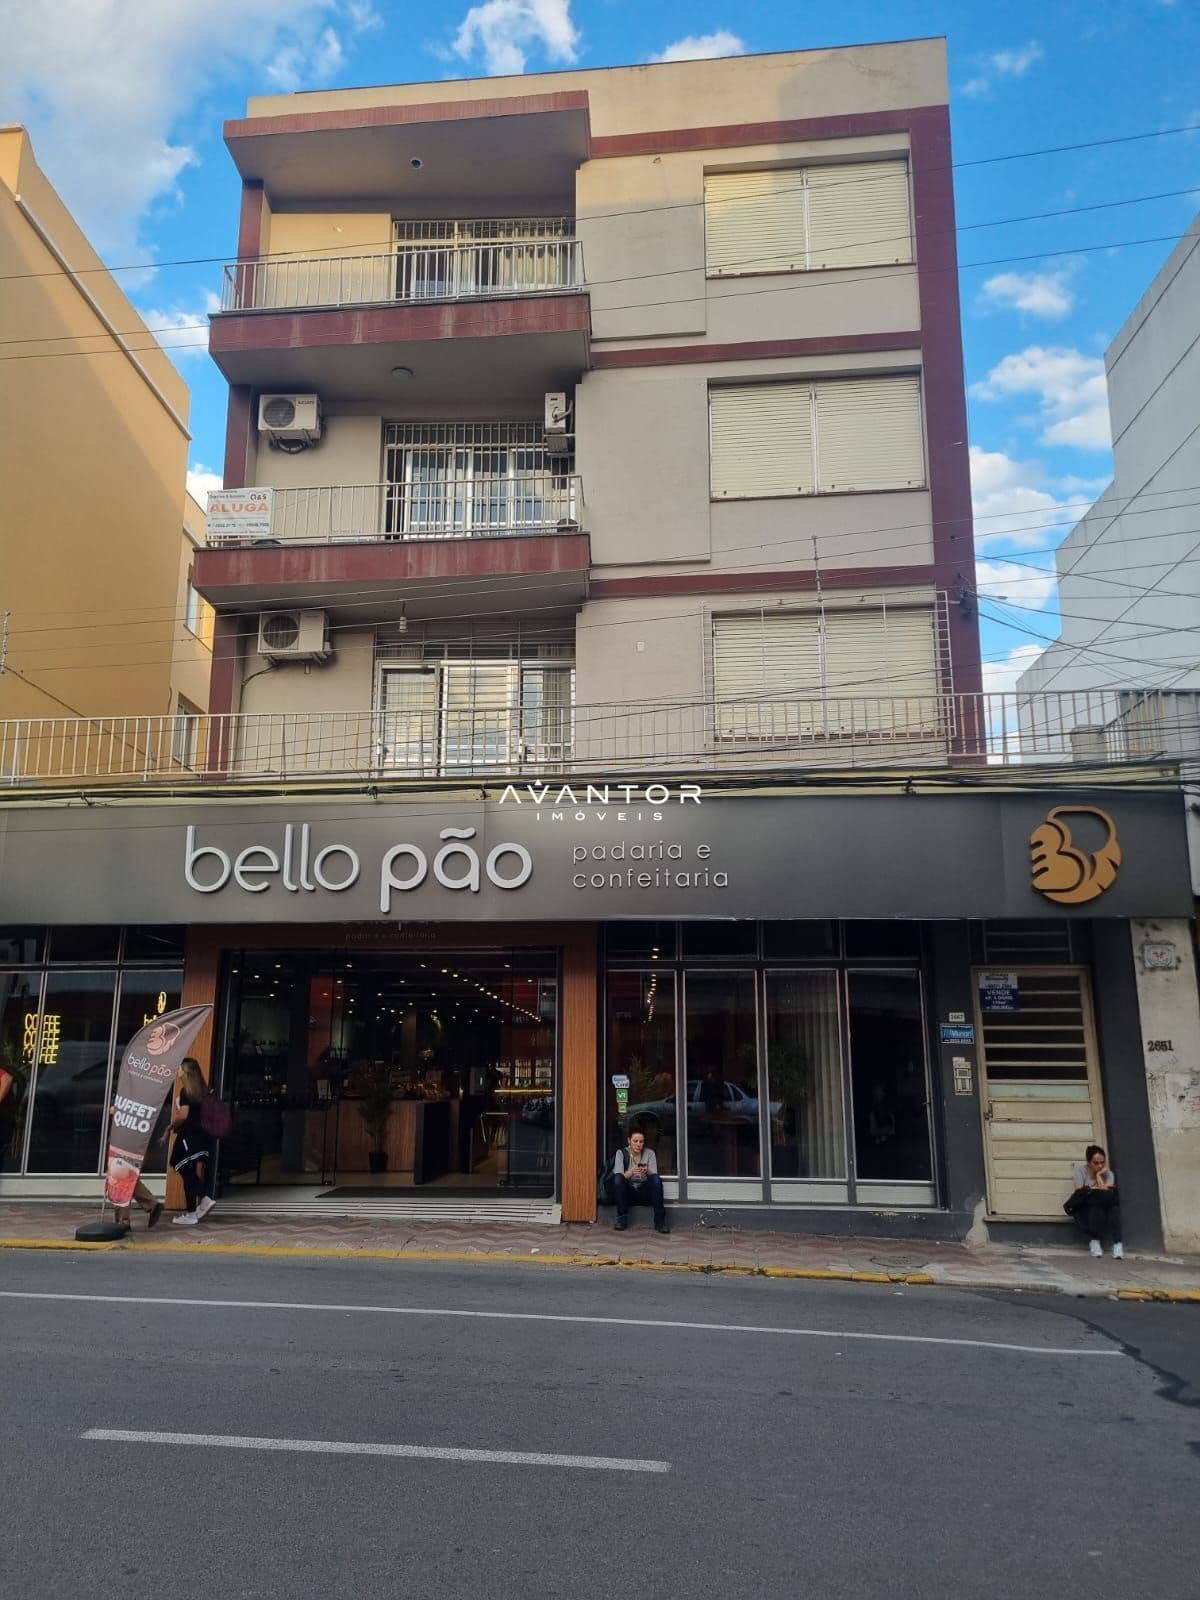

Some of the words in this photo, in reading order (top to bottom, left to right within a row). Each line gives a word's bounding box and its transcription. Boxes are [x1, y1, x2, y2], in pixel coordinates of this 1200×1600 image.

[209, 502, 269, 513] ALUGA
[572, 840, 683, 864] padaria
[696, 843, 712, 859] e
[184, 823, 361, 893] bello
[380, 826, 533, 913] pão
[572, 867, 729, 889] confeitaria
[24, 1013, 61, 1031] COFEE
[23, 1031, 60, 1048] COFEE
[22, 1047, 58, 1064] COFEE
[127, 1052, 151, 1071] bello
[148, 1064, 172, 1077] pão
[114, 1110, 150, 1133] QUILO
